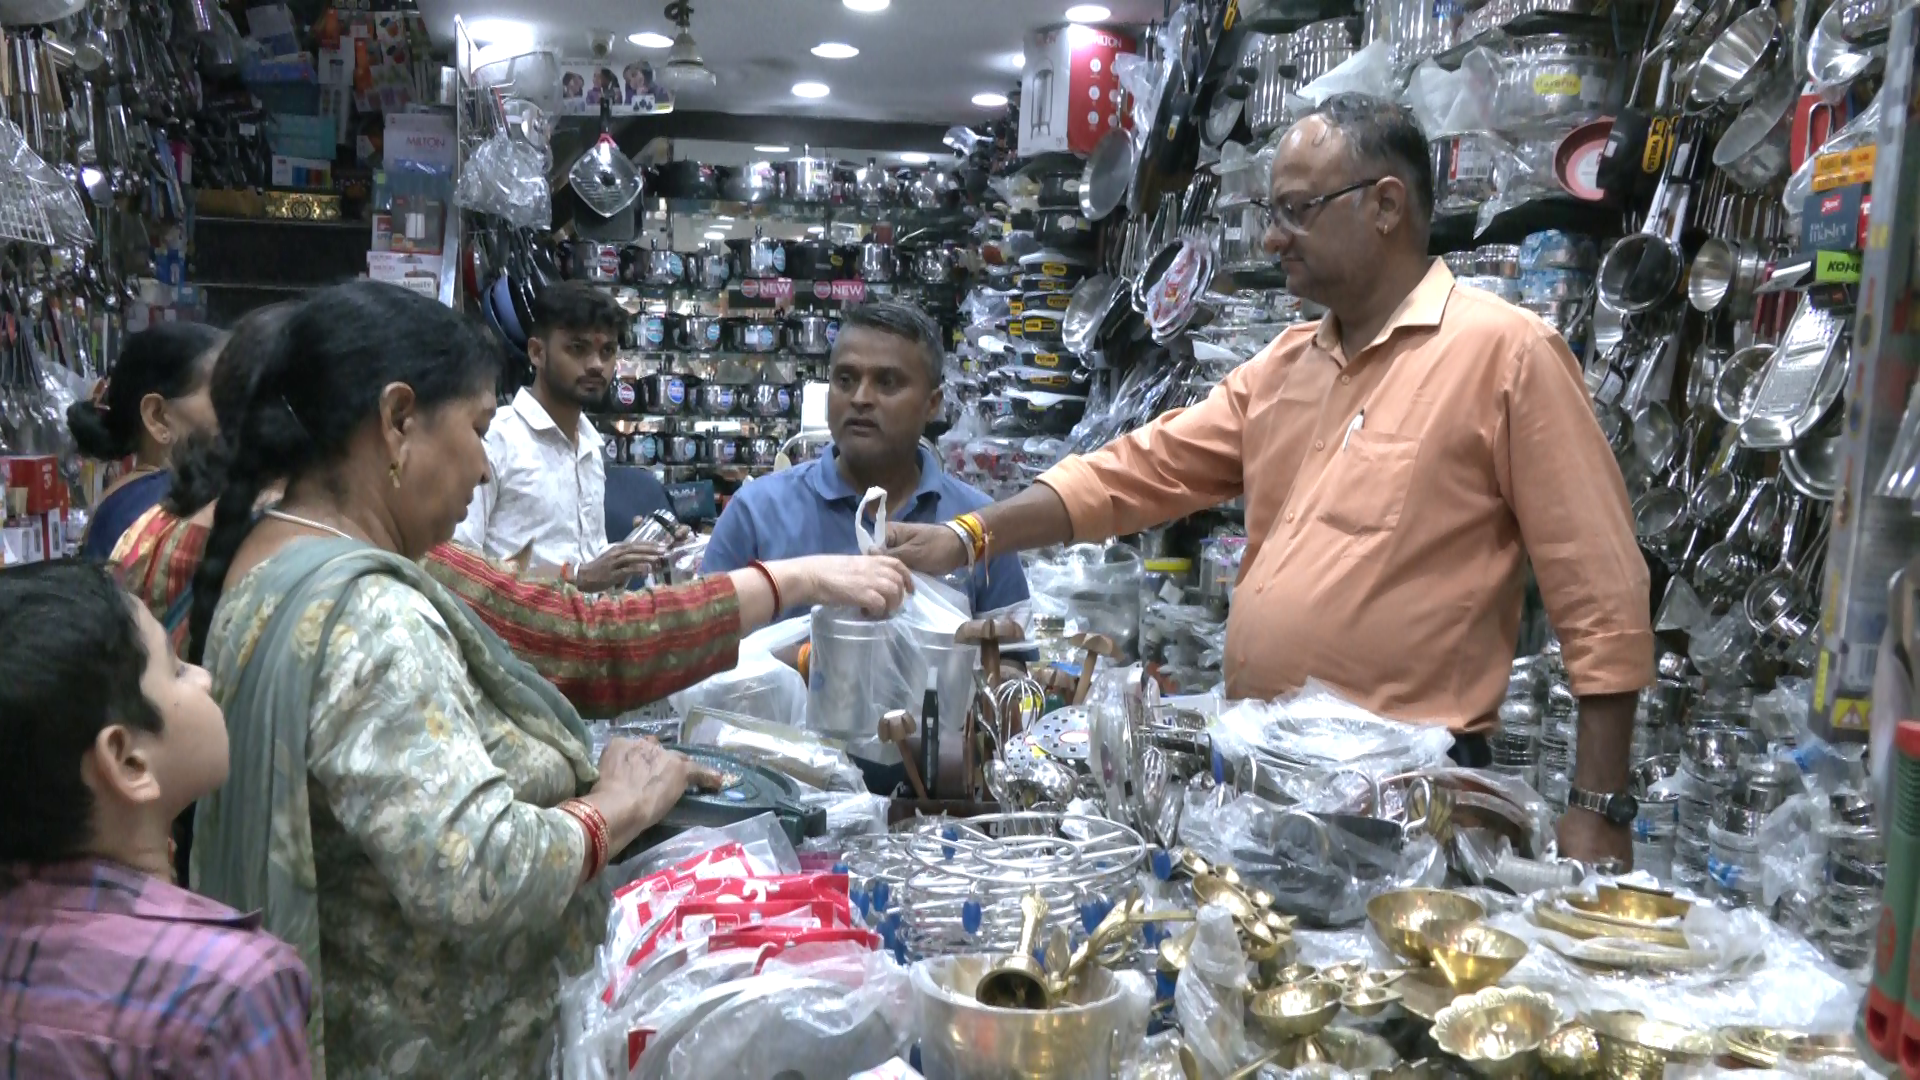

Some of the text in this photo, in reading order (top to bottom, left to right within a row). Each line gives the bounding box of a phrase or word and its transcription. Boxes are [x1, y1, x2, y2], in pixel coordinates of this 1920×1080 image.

[405, 136, 445, 148] MILTON
[760, 282, 791, 294] NEW
[832, 284, 863, 296] NEW
